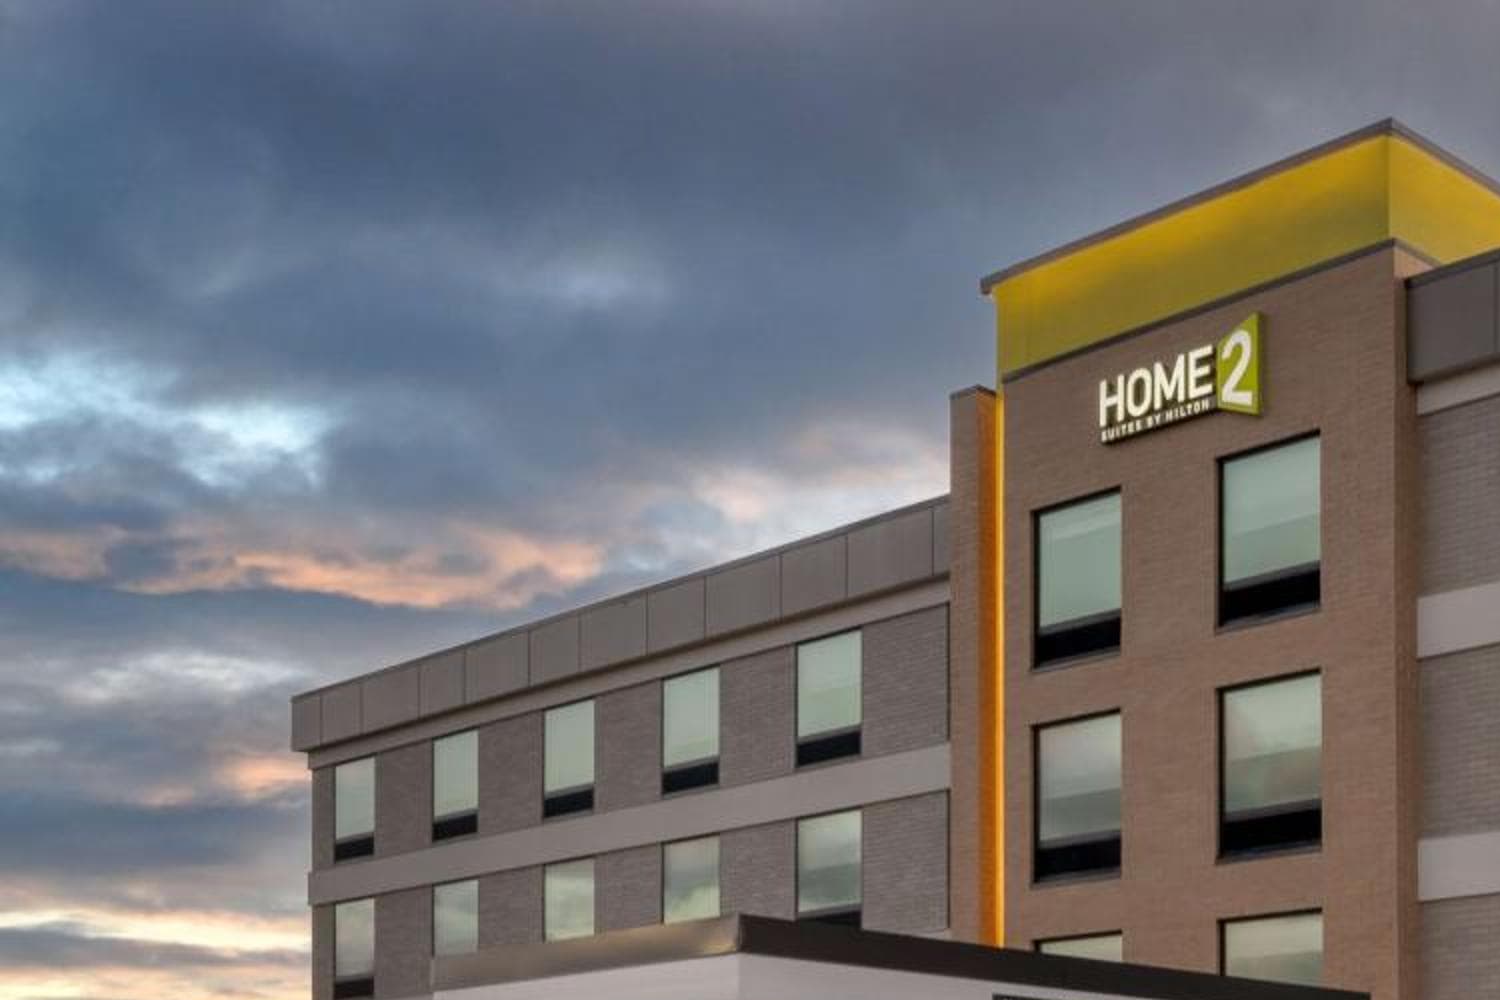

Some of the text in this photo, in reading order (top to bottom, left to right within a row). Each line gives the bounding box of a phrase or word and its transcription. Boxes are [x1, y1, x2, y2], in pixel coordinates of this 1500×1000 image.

[1100, 330, 1253, 427] HOME 2
[1101, 397, 1210, 443] SUITES BY HILTON
